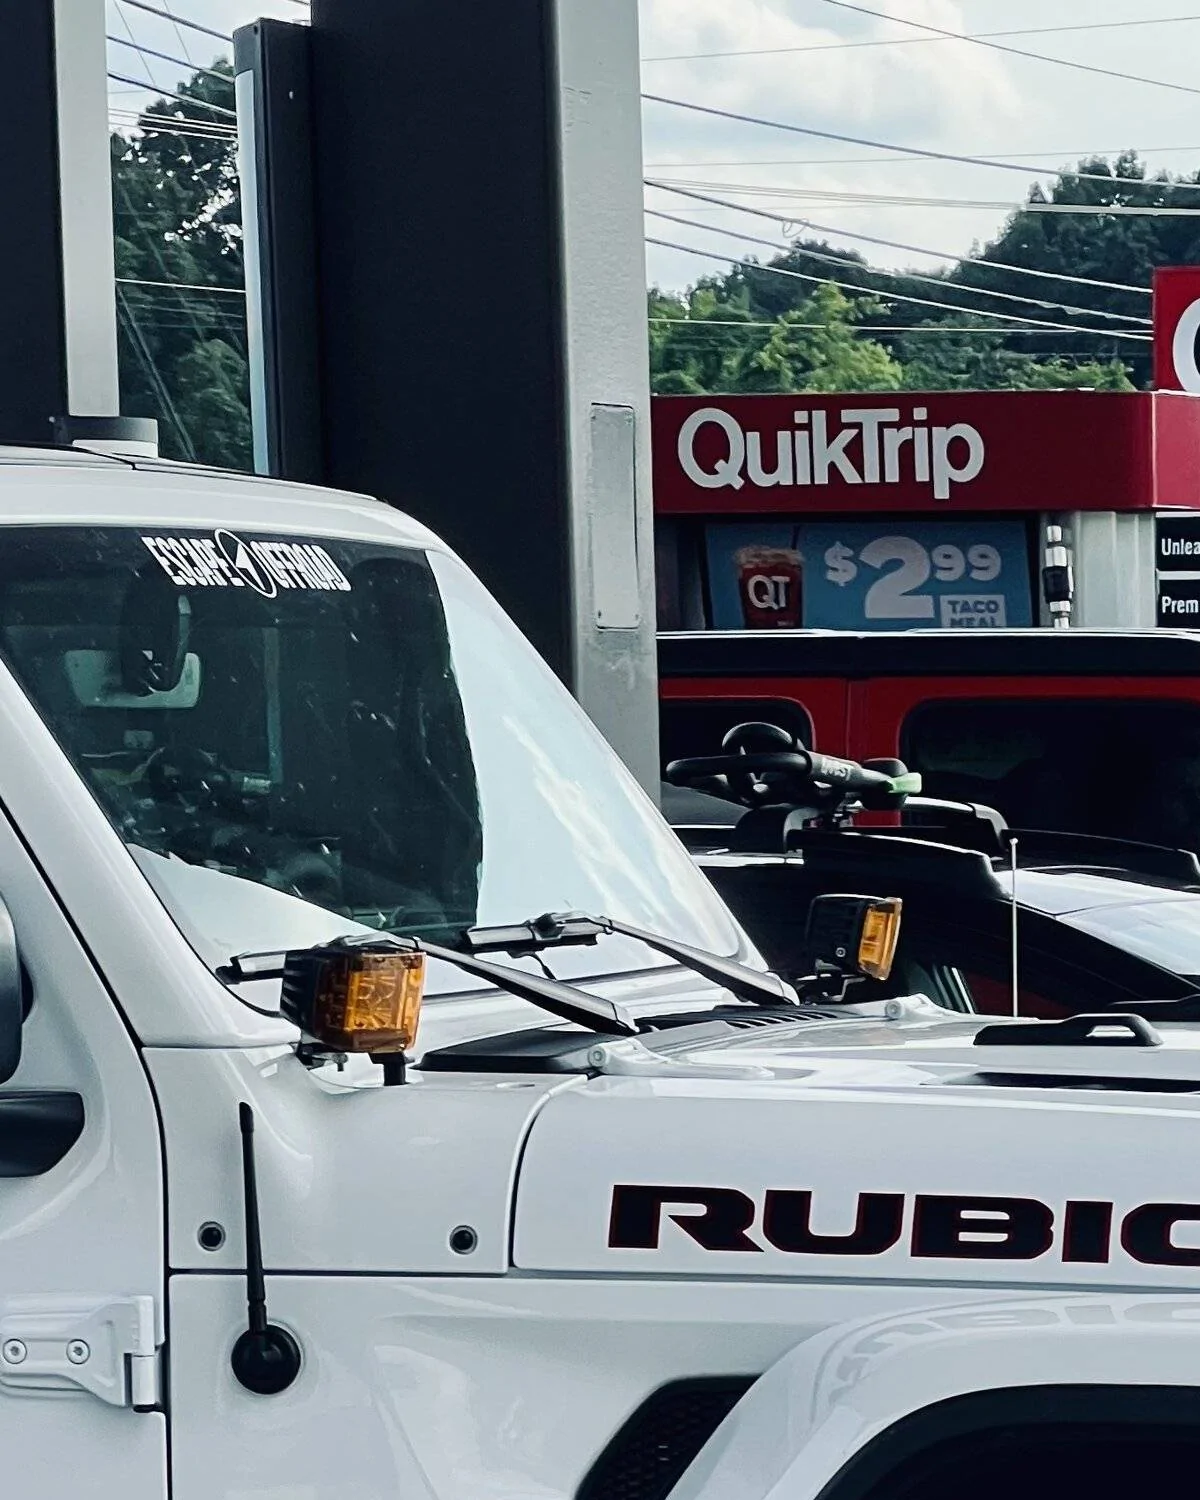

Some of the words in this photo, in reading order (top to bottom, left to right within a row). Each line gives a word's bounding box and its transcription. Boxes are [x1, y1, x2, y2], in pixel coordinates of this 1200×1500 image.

[678, 407, 985, 499] QuikTrip
[141, 537, 245, 586] ESCAPE
[249, 540, 352, 591] OFFROAD
[747, 574, 791, 610] QT
[947, 600, 1000, 614] TACO
[1161, 596, 1199, 614] Prem
